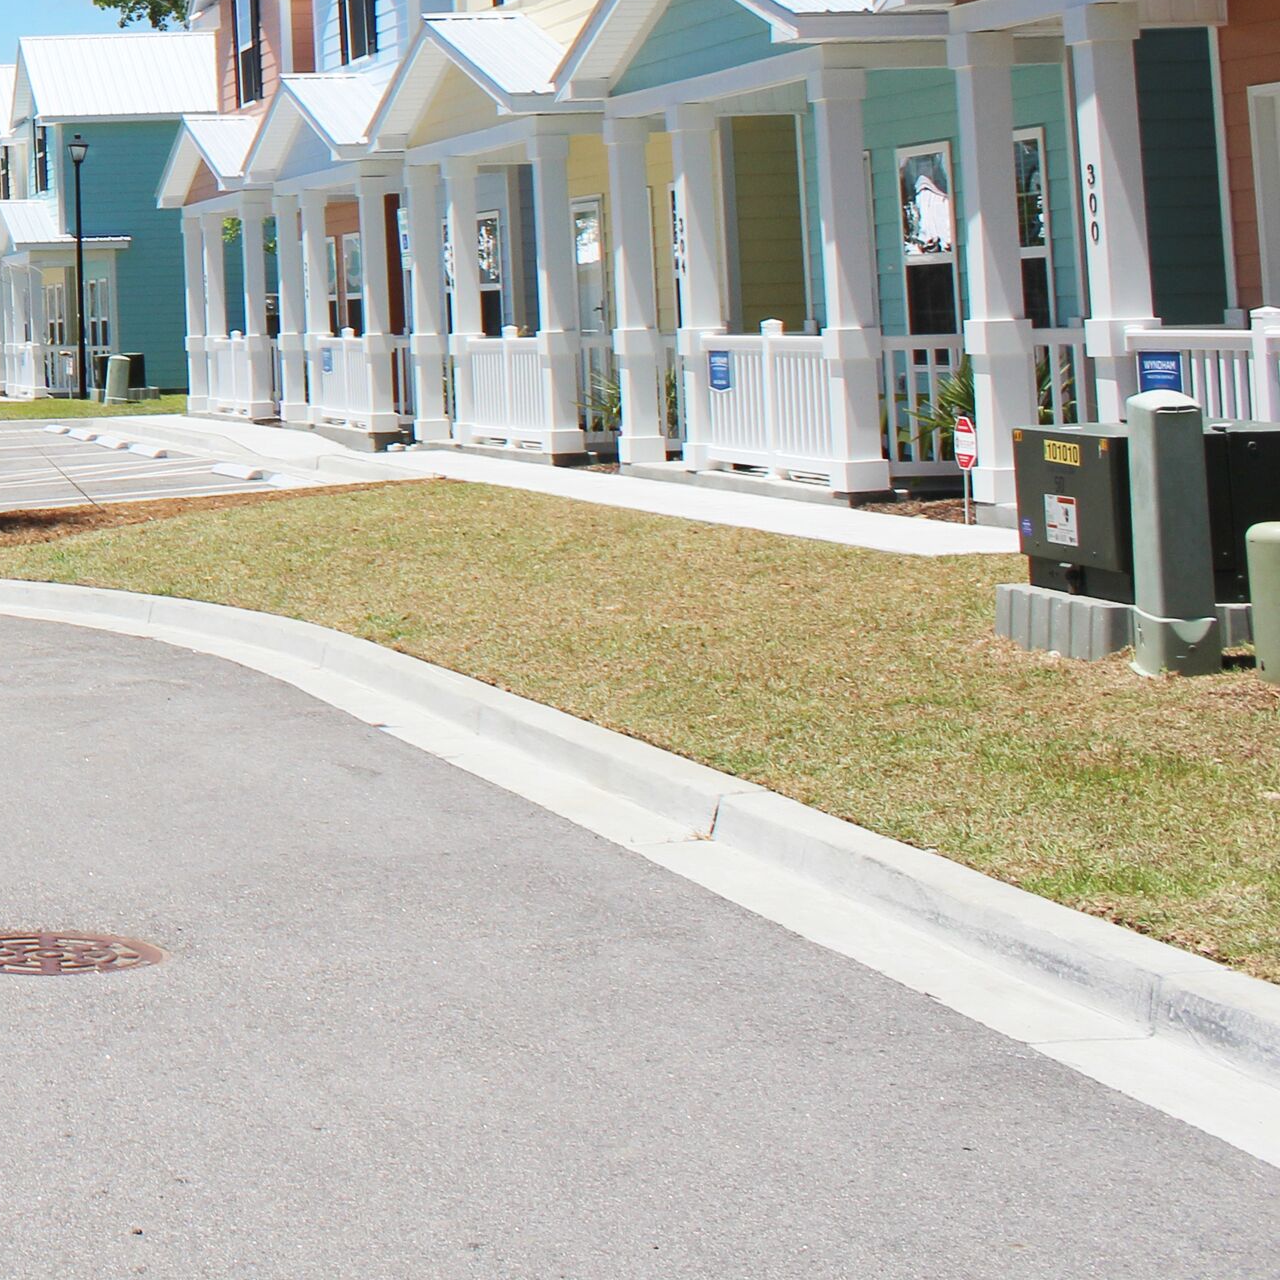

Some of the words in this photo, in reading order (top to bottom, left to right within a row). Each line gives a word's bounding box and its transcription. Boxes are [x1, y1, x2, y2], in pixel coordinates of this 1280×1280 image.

[1086, 164, 1100, 242] 300
[1143, 360, 1176, 370] WYNDHAM
[1047, 442, 1079, 463] 101010
